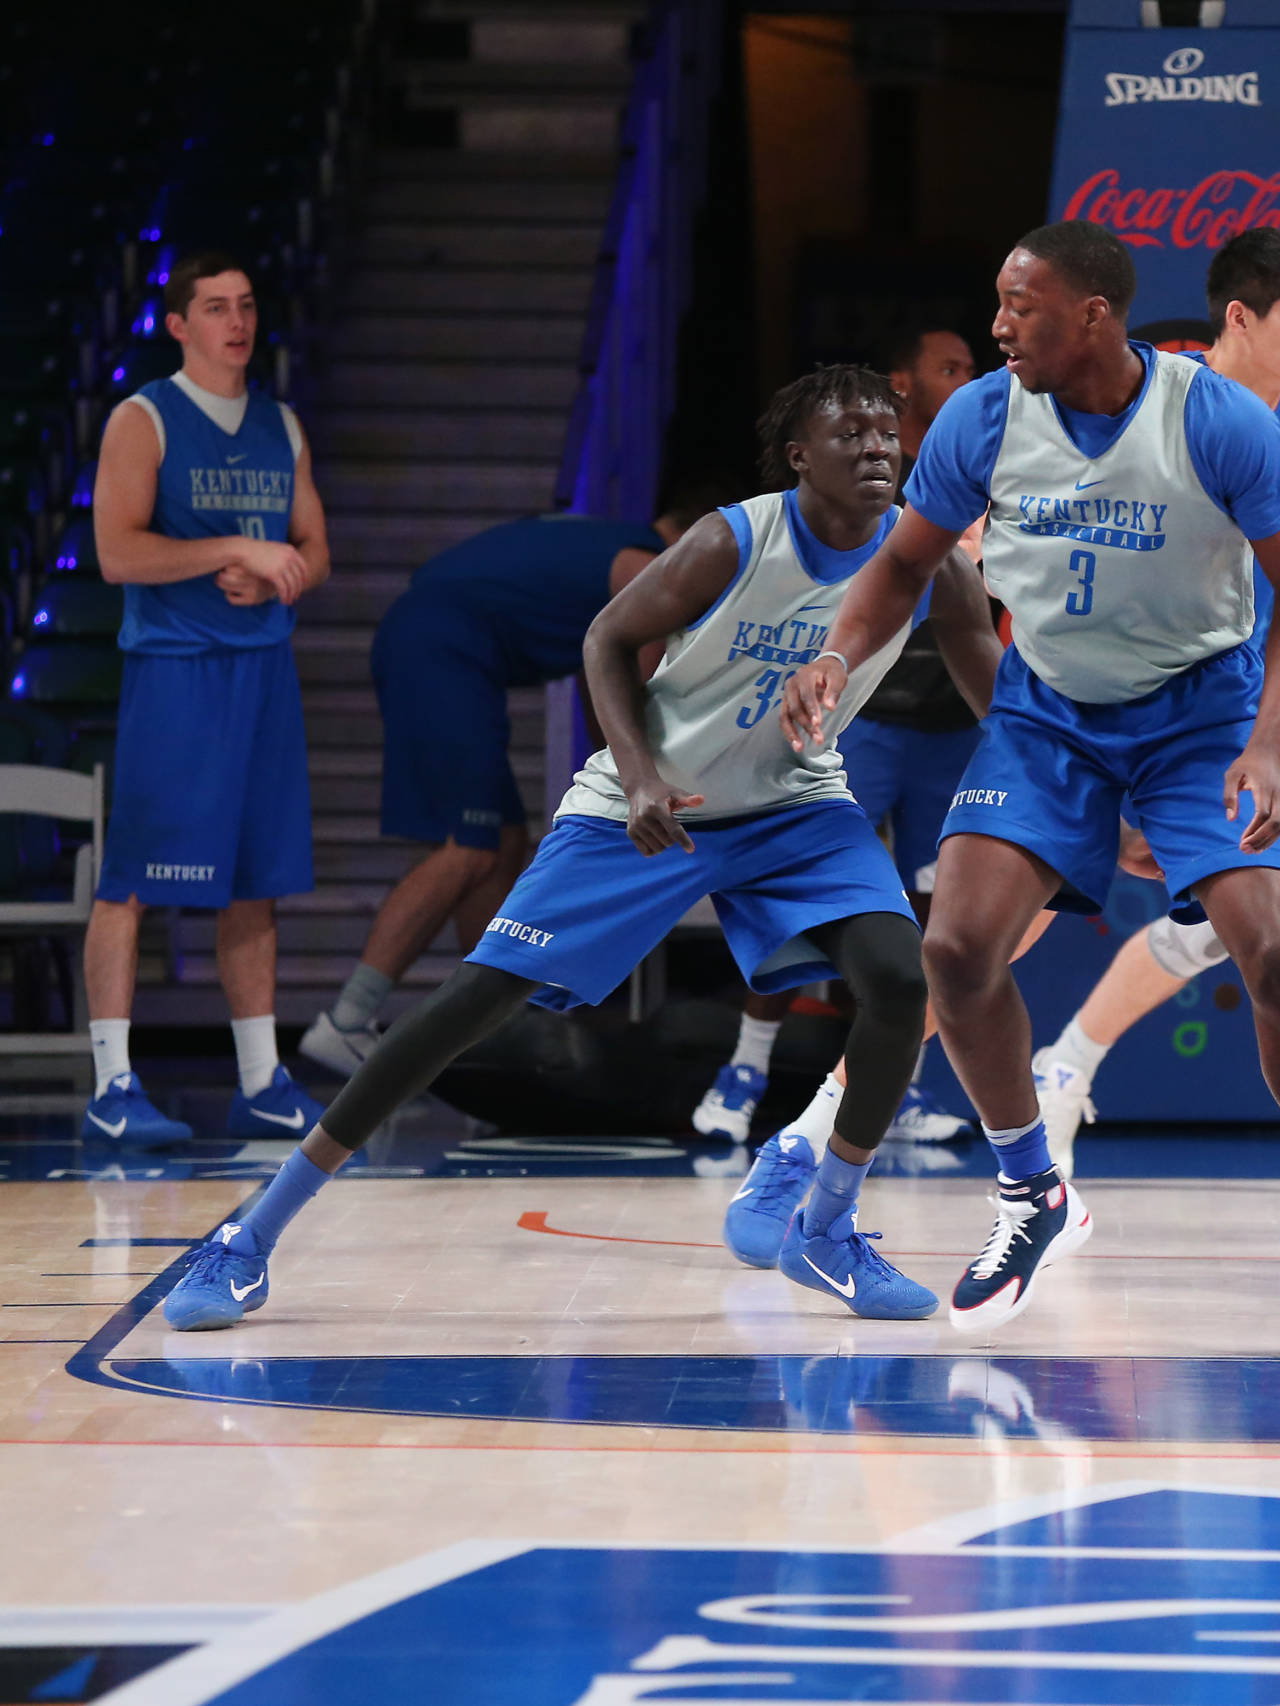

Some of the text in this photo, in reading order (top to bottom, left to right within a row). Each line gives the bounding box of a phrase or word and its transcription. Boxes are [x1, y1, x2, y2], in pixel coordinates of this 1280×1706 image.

[1104, 72, 1262, 106] SPALDING
[190, 468, 292, 495] KENTUCKY
[1019, 495, 1167, 532] KENTUCKY
[1022, 522, 1159, 550] ASKETBALL
[1065, 549, 1096, 616] 3
[732, 620, 829, 649] KENTU
[145, 863, 216, 881] KENTUCKY
